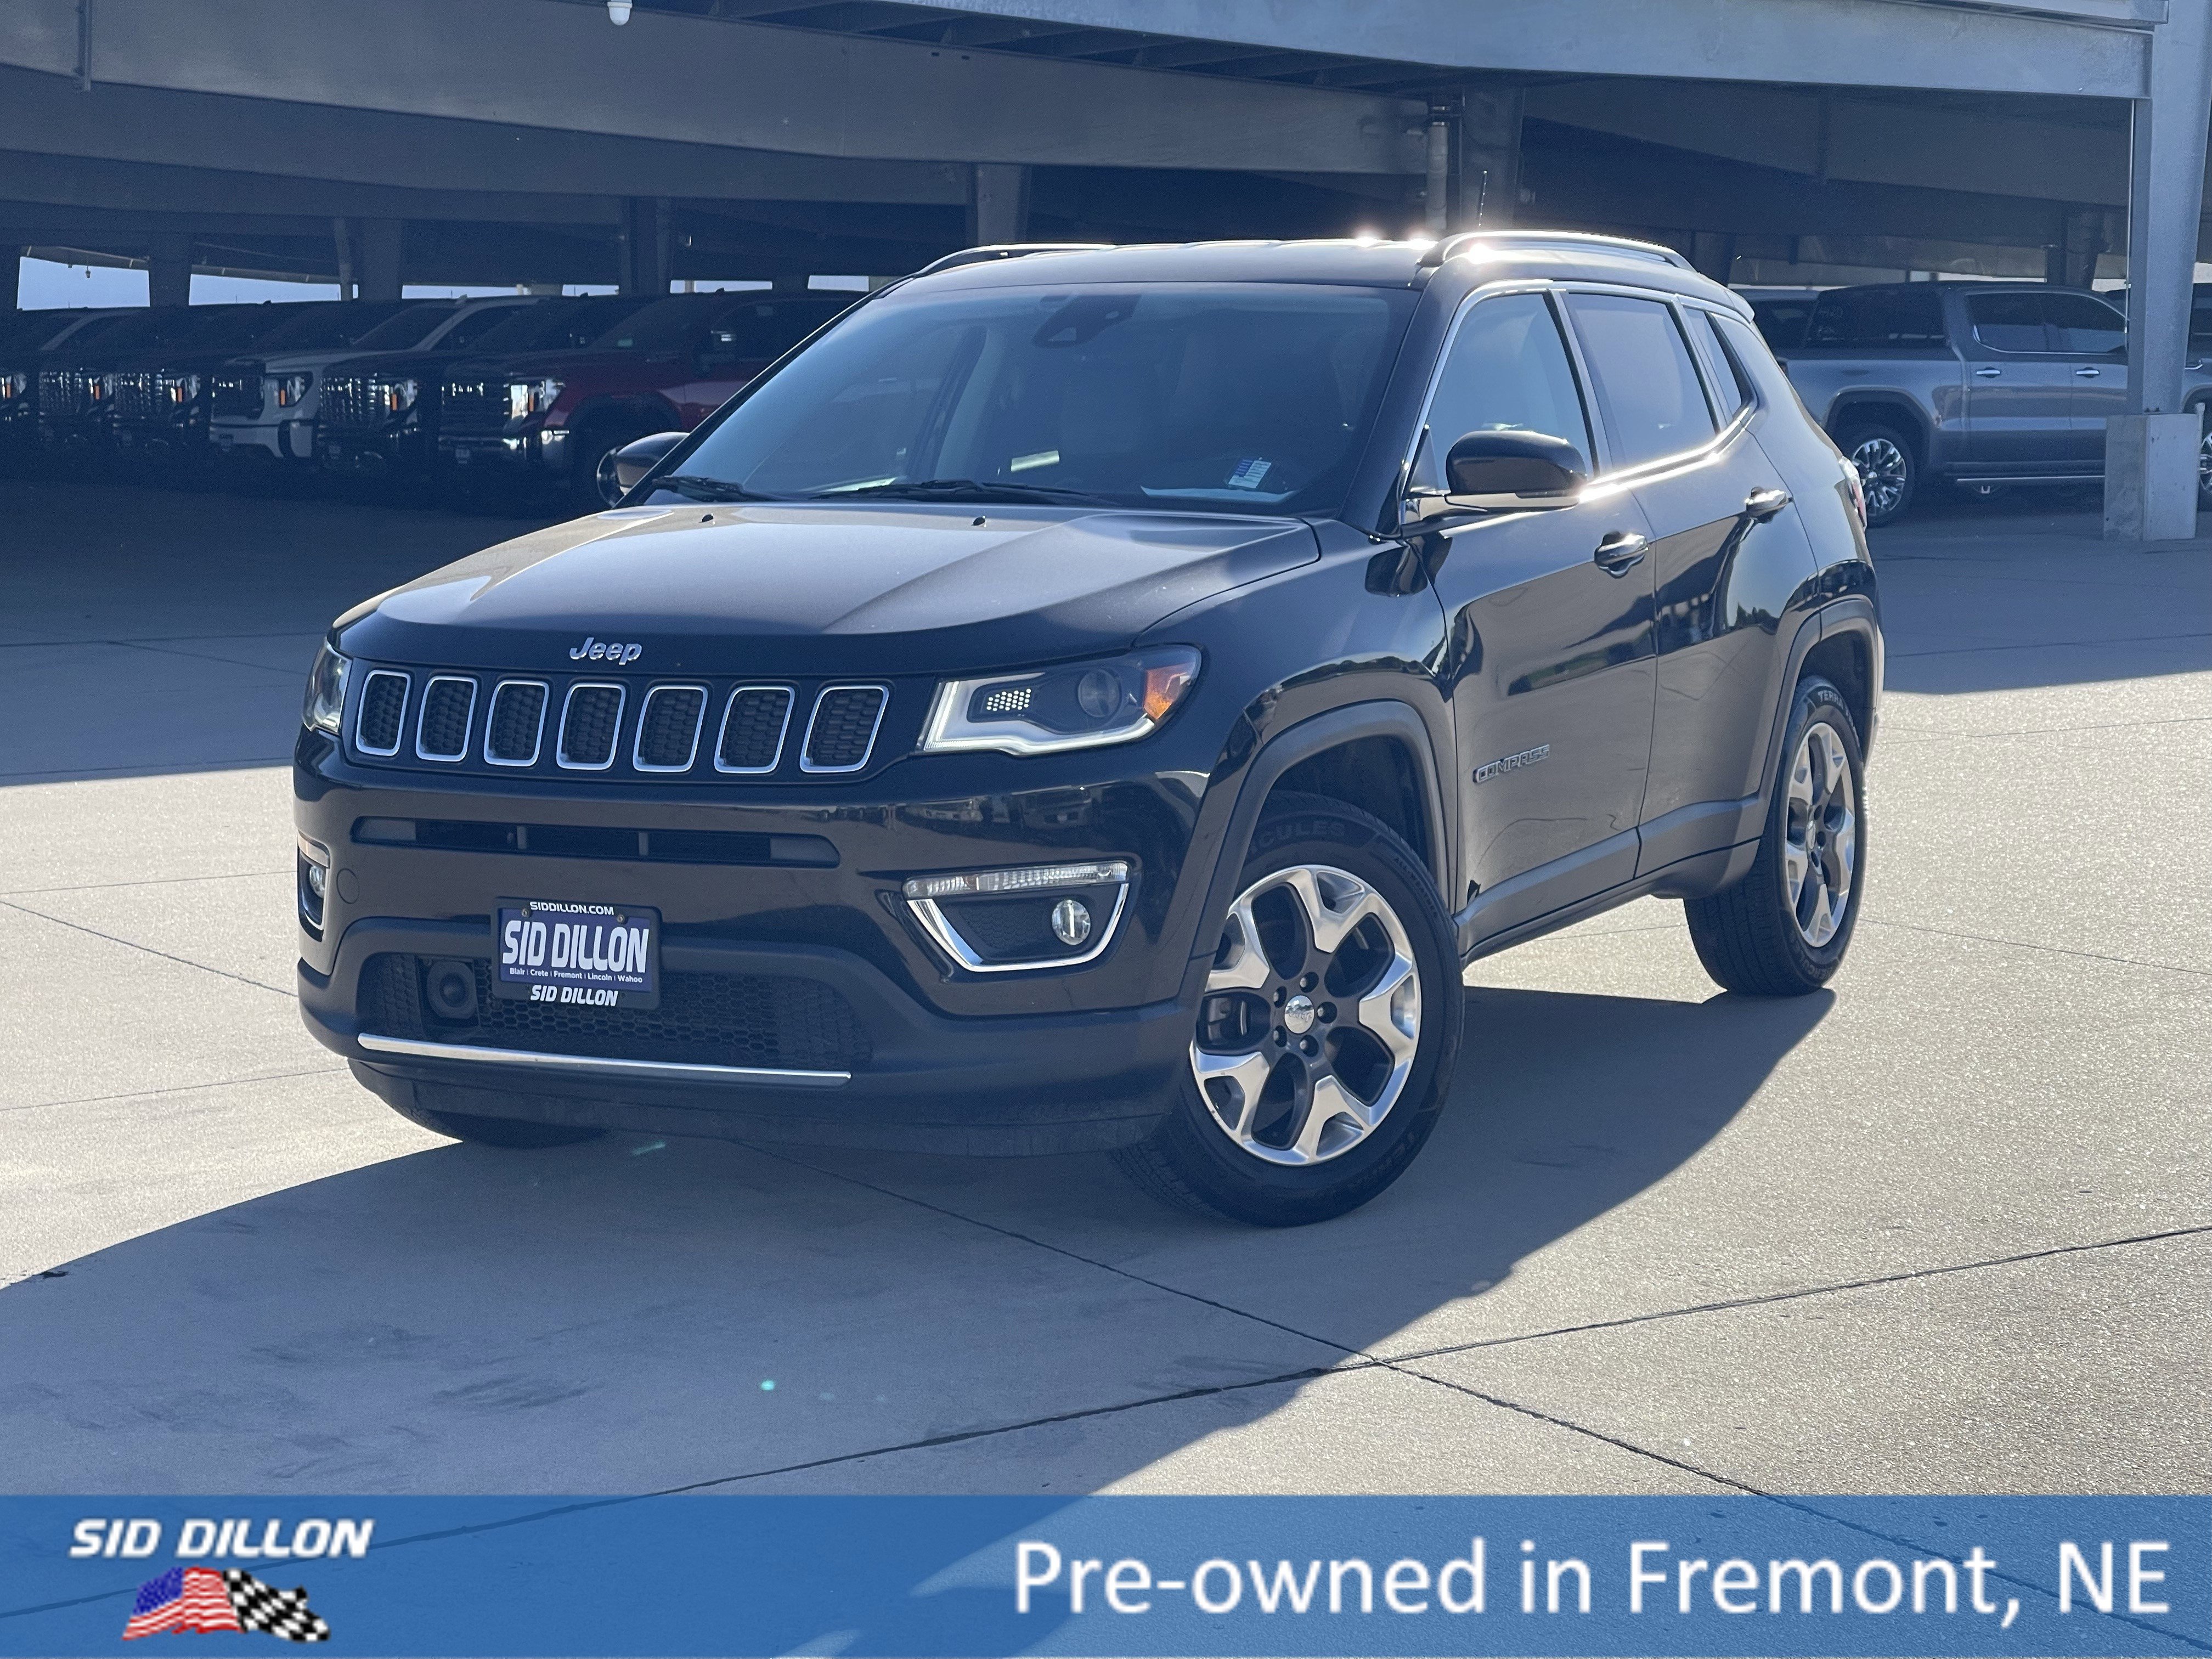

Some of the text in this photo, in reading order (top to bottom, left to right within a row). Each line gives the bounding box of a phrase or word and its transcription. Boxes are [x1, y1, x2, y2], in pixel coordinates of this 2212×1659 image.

[569, 637, 642, 665] Jeep
[1476, 744, 1550, 783] COMPASS
[530, 901, 614, 915] SIDDILLON.COM
[503, 920, 649, 973] SID DILLON
[510, 967, 525, 975] Blair
[554, 970, 582, 979] Fremont
[588, 973, 612, 981] Lincoln
[617, 975, 642, 983] Wahoo
[531, 985, 618, 1006] SID DILLON
